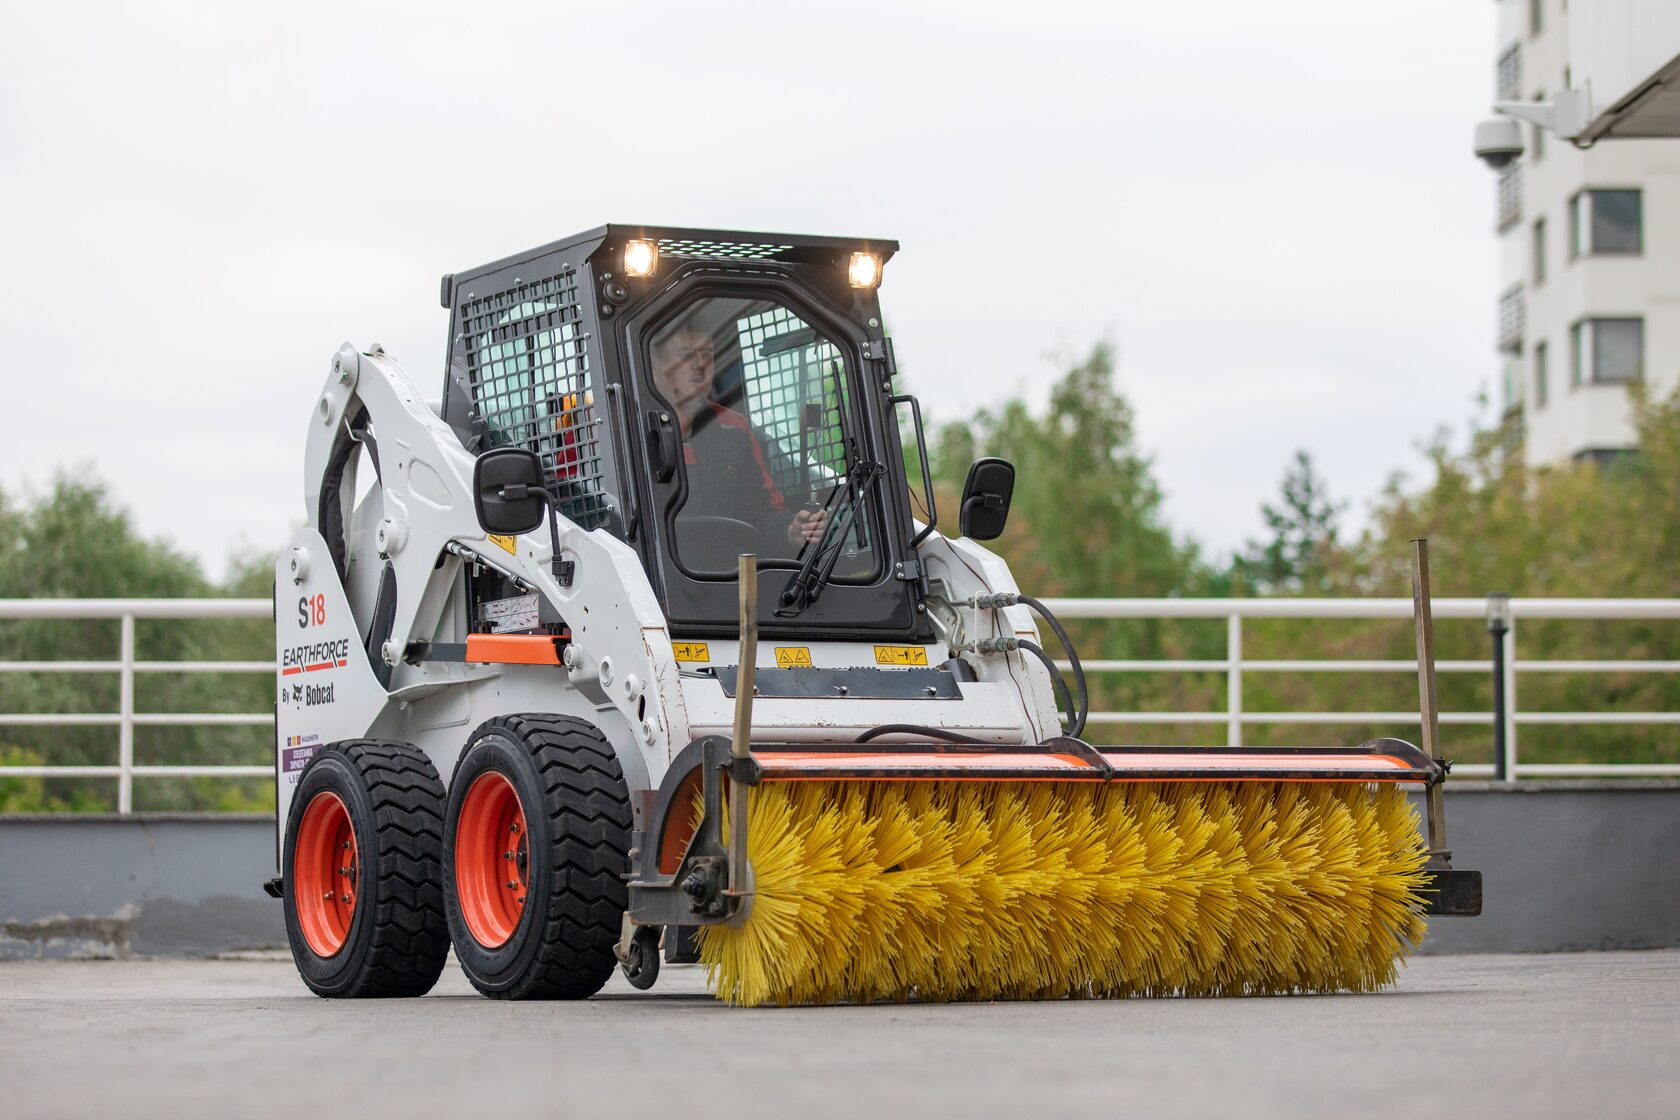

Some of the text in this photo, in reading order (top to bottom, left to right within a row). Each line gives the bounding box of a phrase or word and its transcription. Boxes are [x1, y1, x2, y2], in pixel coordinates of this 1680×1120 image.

[298, 593, 326, 629] S18
[282, 638, 349, 673] EARTHFORCE
[282, 682, 334, 706] By Bobcat
